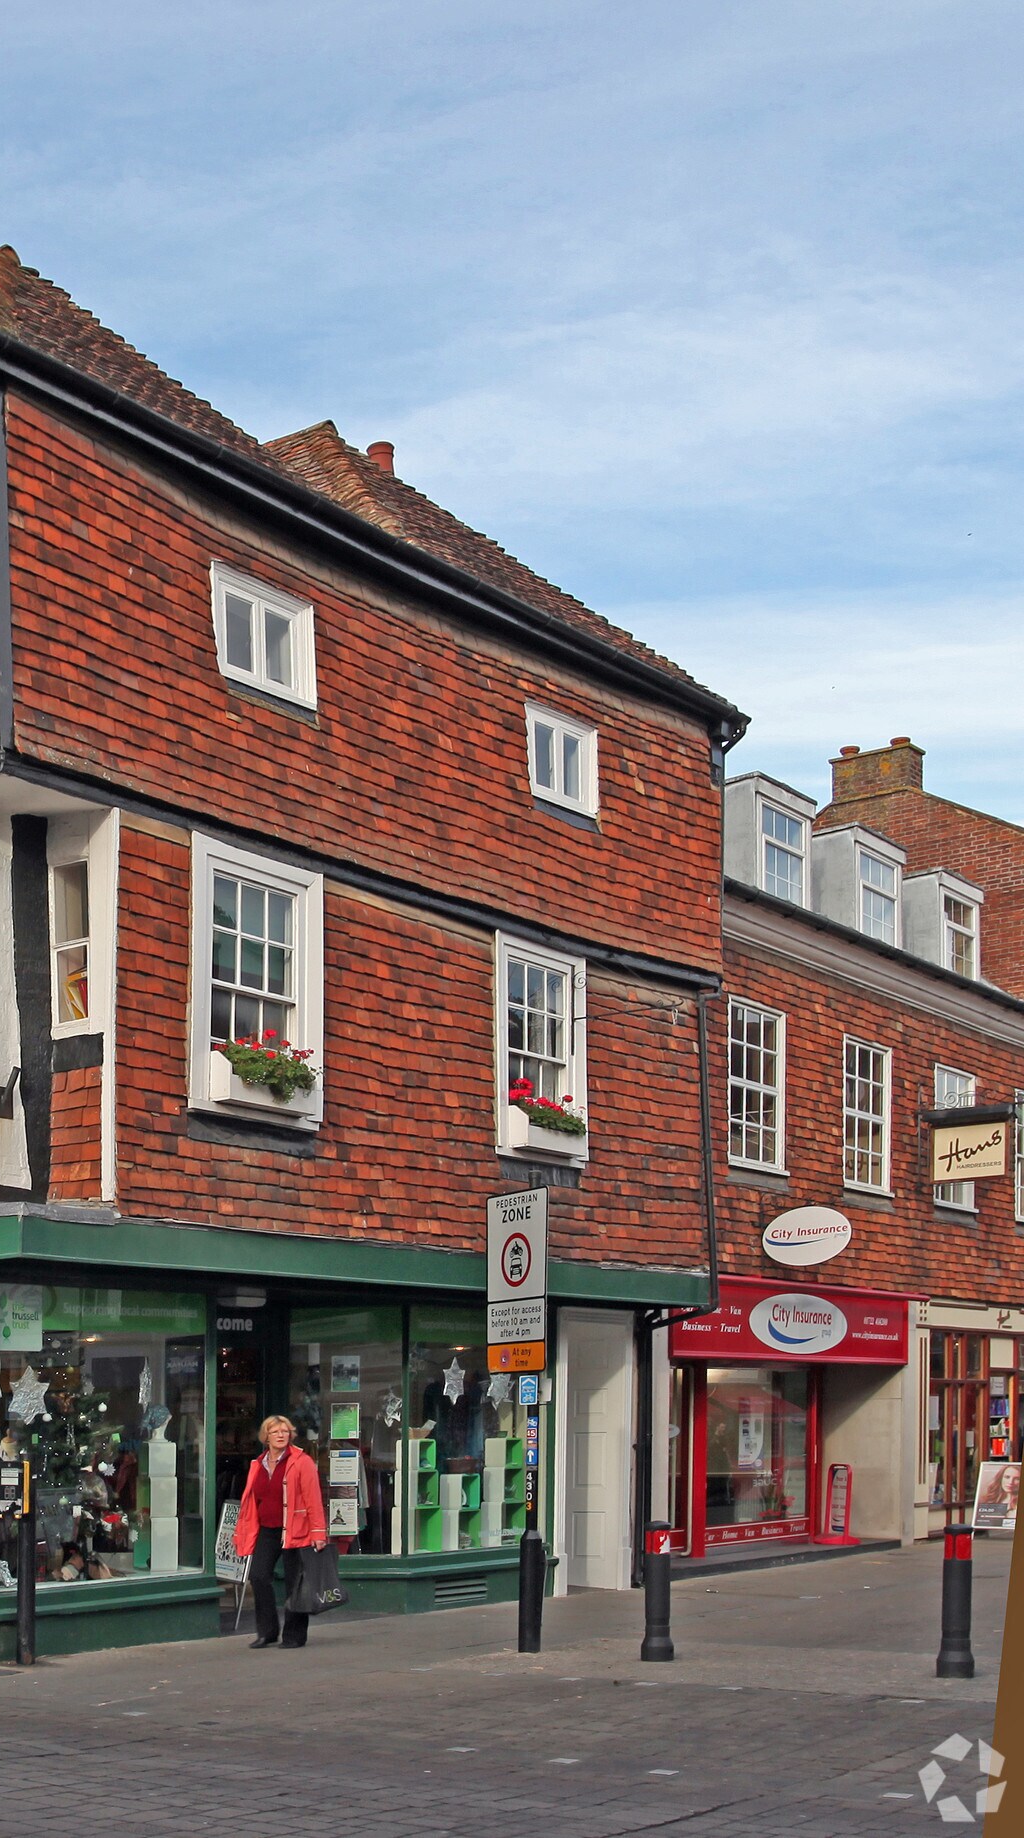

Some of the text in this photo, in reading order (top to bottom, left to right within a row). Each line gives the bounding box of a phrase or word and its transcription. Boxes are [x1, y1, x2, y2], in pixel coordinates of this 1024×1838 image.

[938, 1129, 1002, 1172] Hans
[956, 1161, 1002, 1170] HAIRDRESSERS
[496, 1193, 538, 1209] PEDESTRIAN
[502, 1206, 531, 1223] ZONE
[771, 1224, 848, 1240] City Insurance
[12, 1311, 39, 1321] trussell
[491, 1305, 542, 1318] Except for access
[730, 1306, 742, 1315] Van
[772, 1304, 832, 1327] City Insurance
[12, 1320, 30, 1329] trust
[216, 1317, 253, 1332] come
[491, 1318, 509, 1328] before
[511, 1317, 518, 1326] 10
[530, 1315, 541, 1325] and
[682, 1320, 741, 1333] Business Travel
[500, 1328, 531, 1338] after 4 pm
[512, 1347, 532, 1357] At any
[515, 1359, 528, 1367] time
[722, 1530, 738, 1540] Home
[745, 1528, 755, 1537] Van
[762, 1526, 783, 1535] Business
